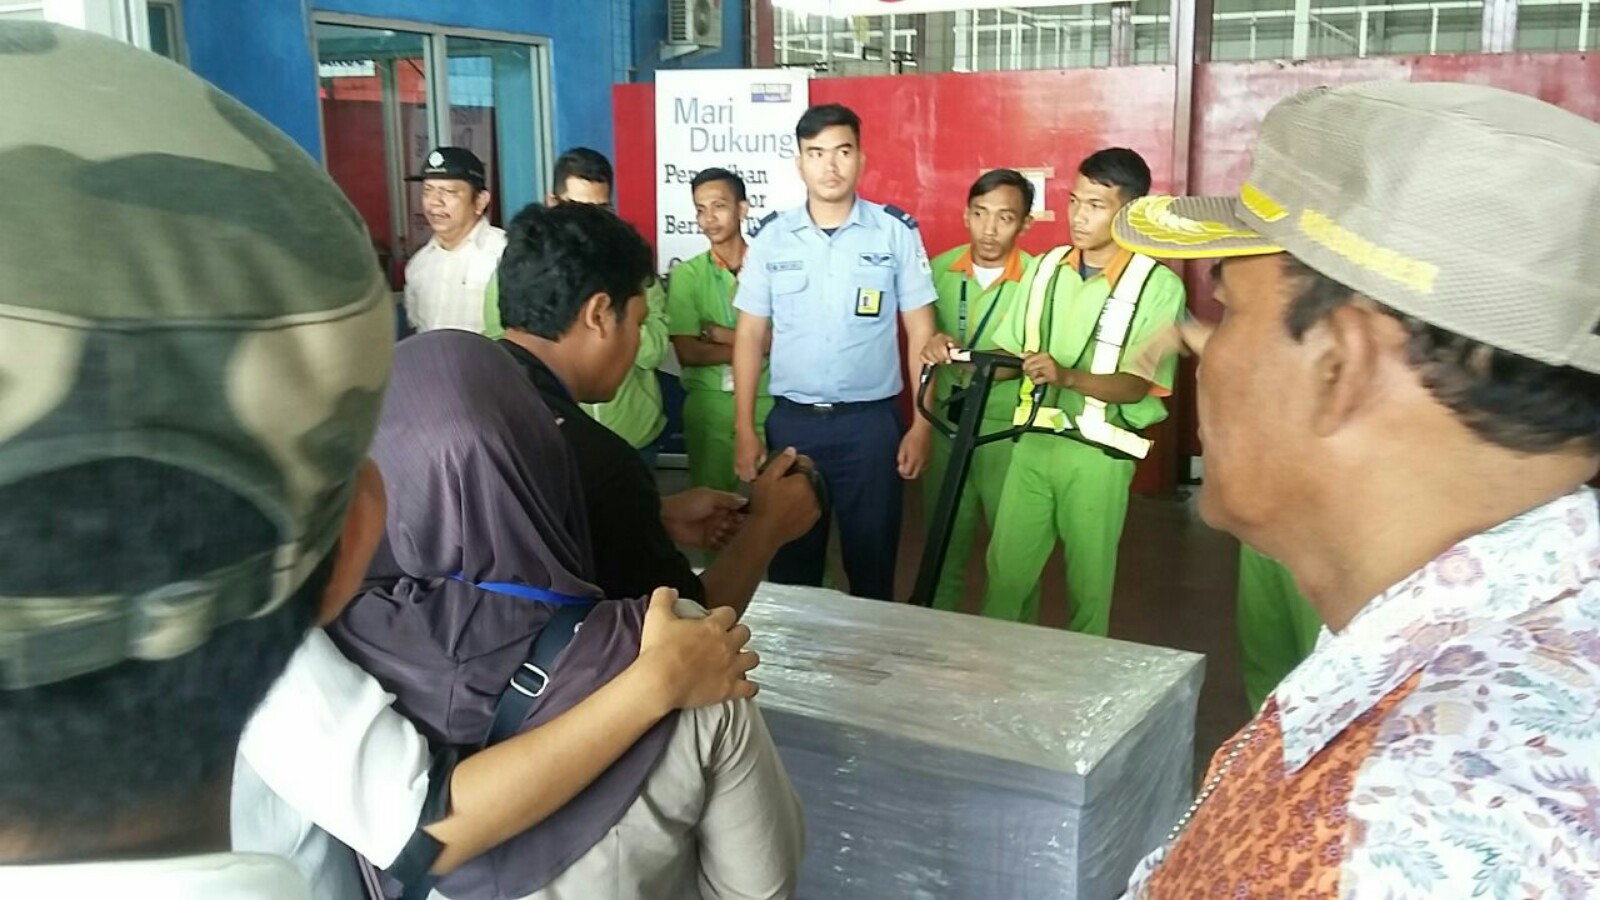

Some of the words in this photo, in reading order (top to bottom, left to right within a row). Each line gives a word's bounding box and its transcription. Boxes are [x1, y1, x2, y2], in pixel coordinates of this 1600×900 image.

[674, 97, 733, 124] Mari
[690, 126, 794, 159] Dukung
[664, 164, 769, 184] Pehan
